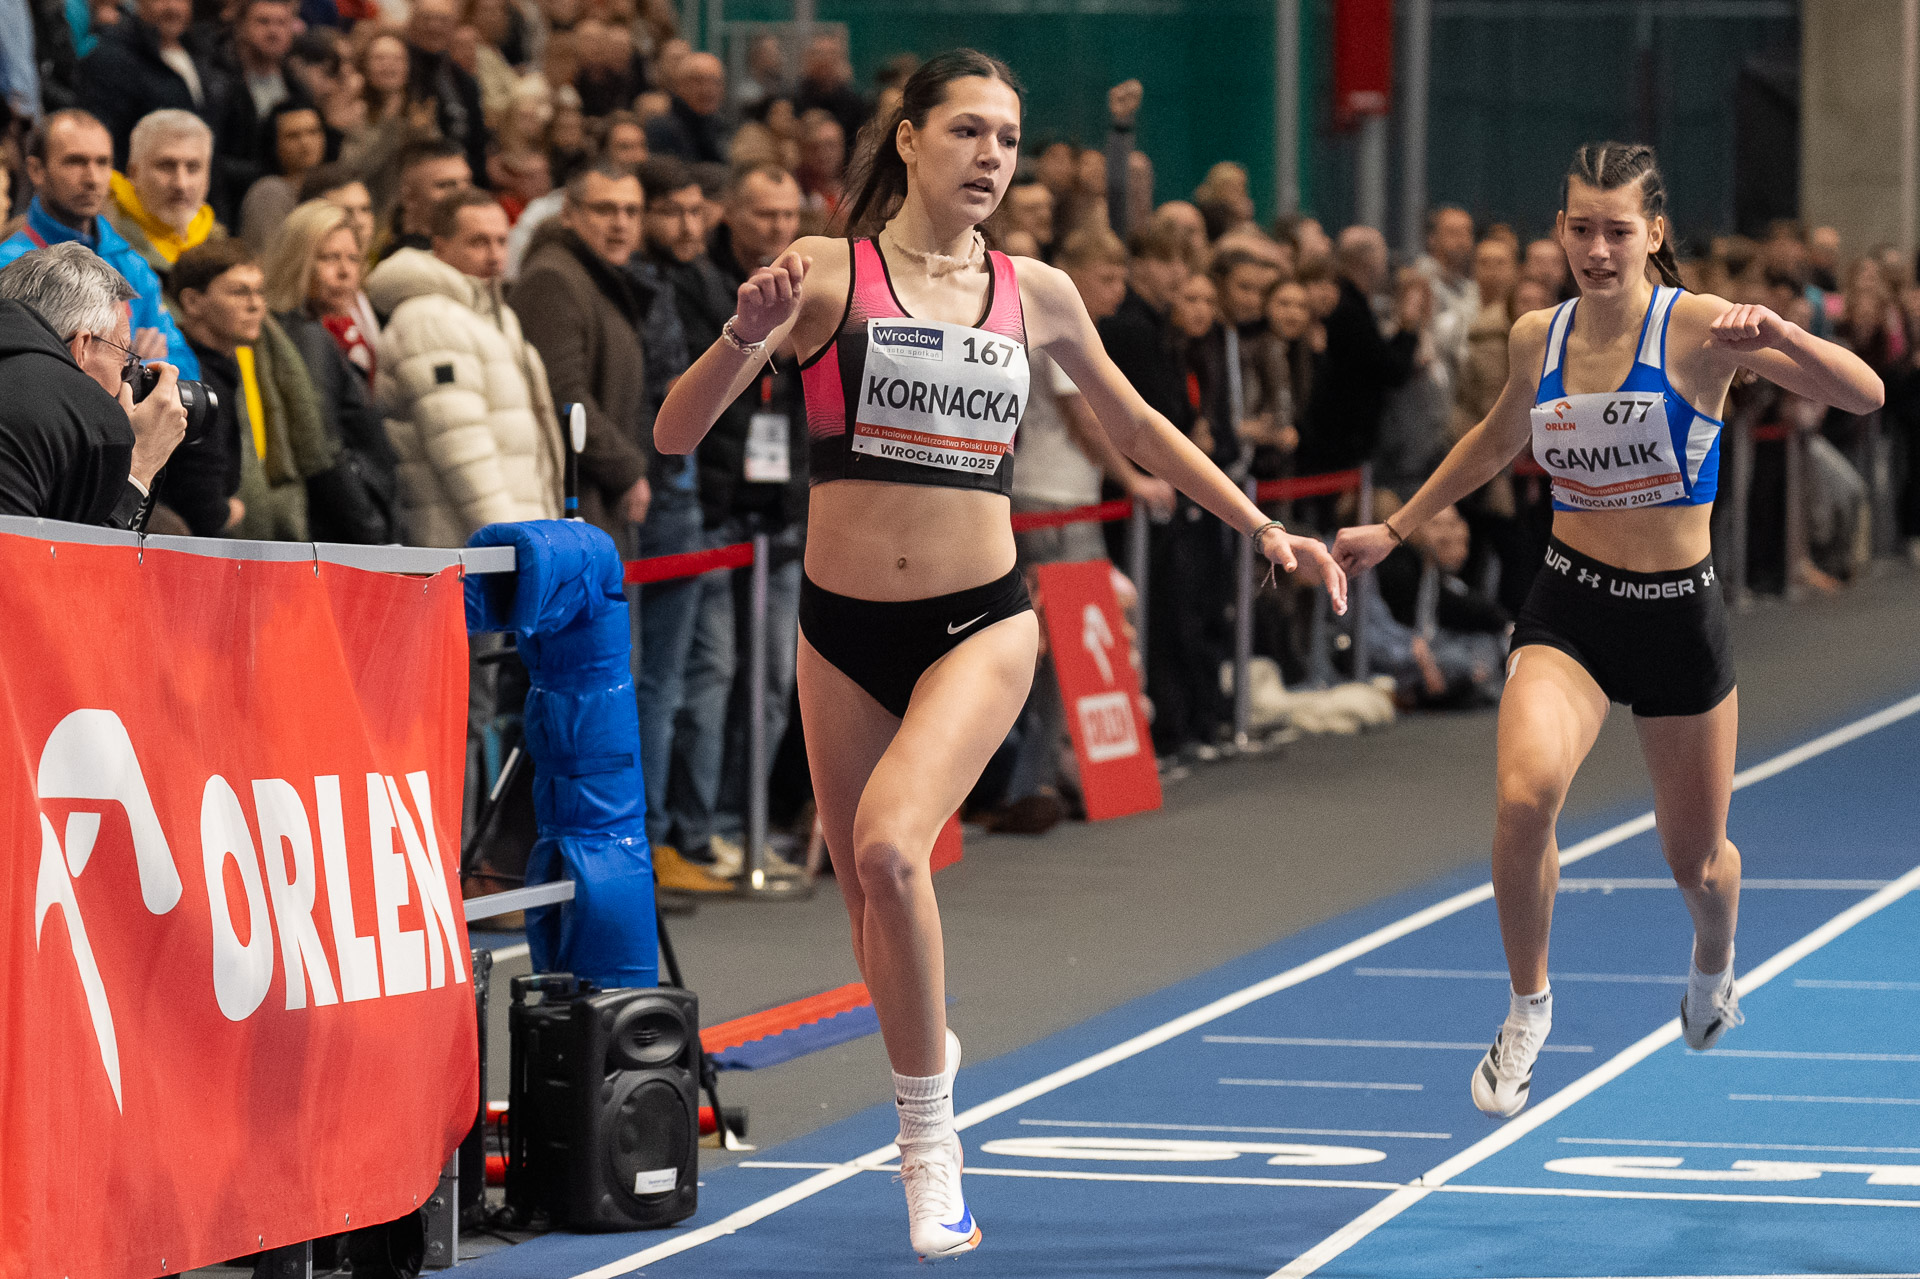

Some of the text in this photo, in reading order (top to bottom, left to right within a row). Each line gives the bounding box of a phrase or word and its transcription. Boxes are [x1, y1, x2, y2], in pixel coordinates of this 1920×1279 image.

[876, 329, 940, 345] Wrocław
[962, 337, 1014, 368] 167
[867, 375, 1019, 425] KORNACKA
[1603, 401, 1653, 425] 677
[1545, 422, 1576, 431] ORLEN
[861, 426, 880, 436] PZLA
[881, 429, 912, 441] Halowe
[913, 434, 959, 448] Mistrzostwa
[960, 440, 982, 451] Polski
[983, 443, 998, 453] U18
[880, 443, 995, 470] WROCŁAW 2025
[1545, 441, 1663, 472] GAWLIK
[1625, 481, 1646, 490] Polski
[1570, 490, 1662, 508] WROCŁAW 2025
[1610, 578, 1696, 599] UNDER
[200, 770, 467, 1021] ORLEN
